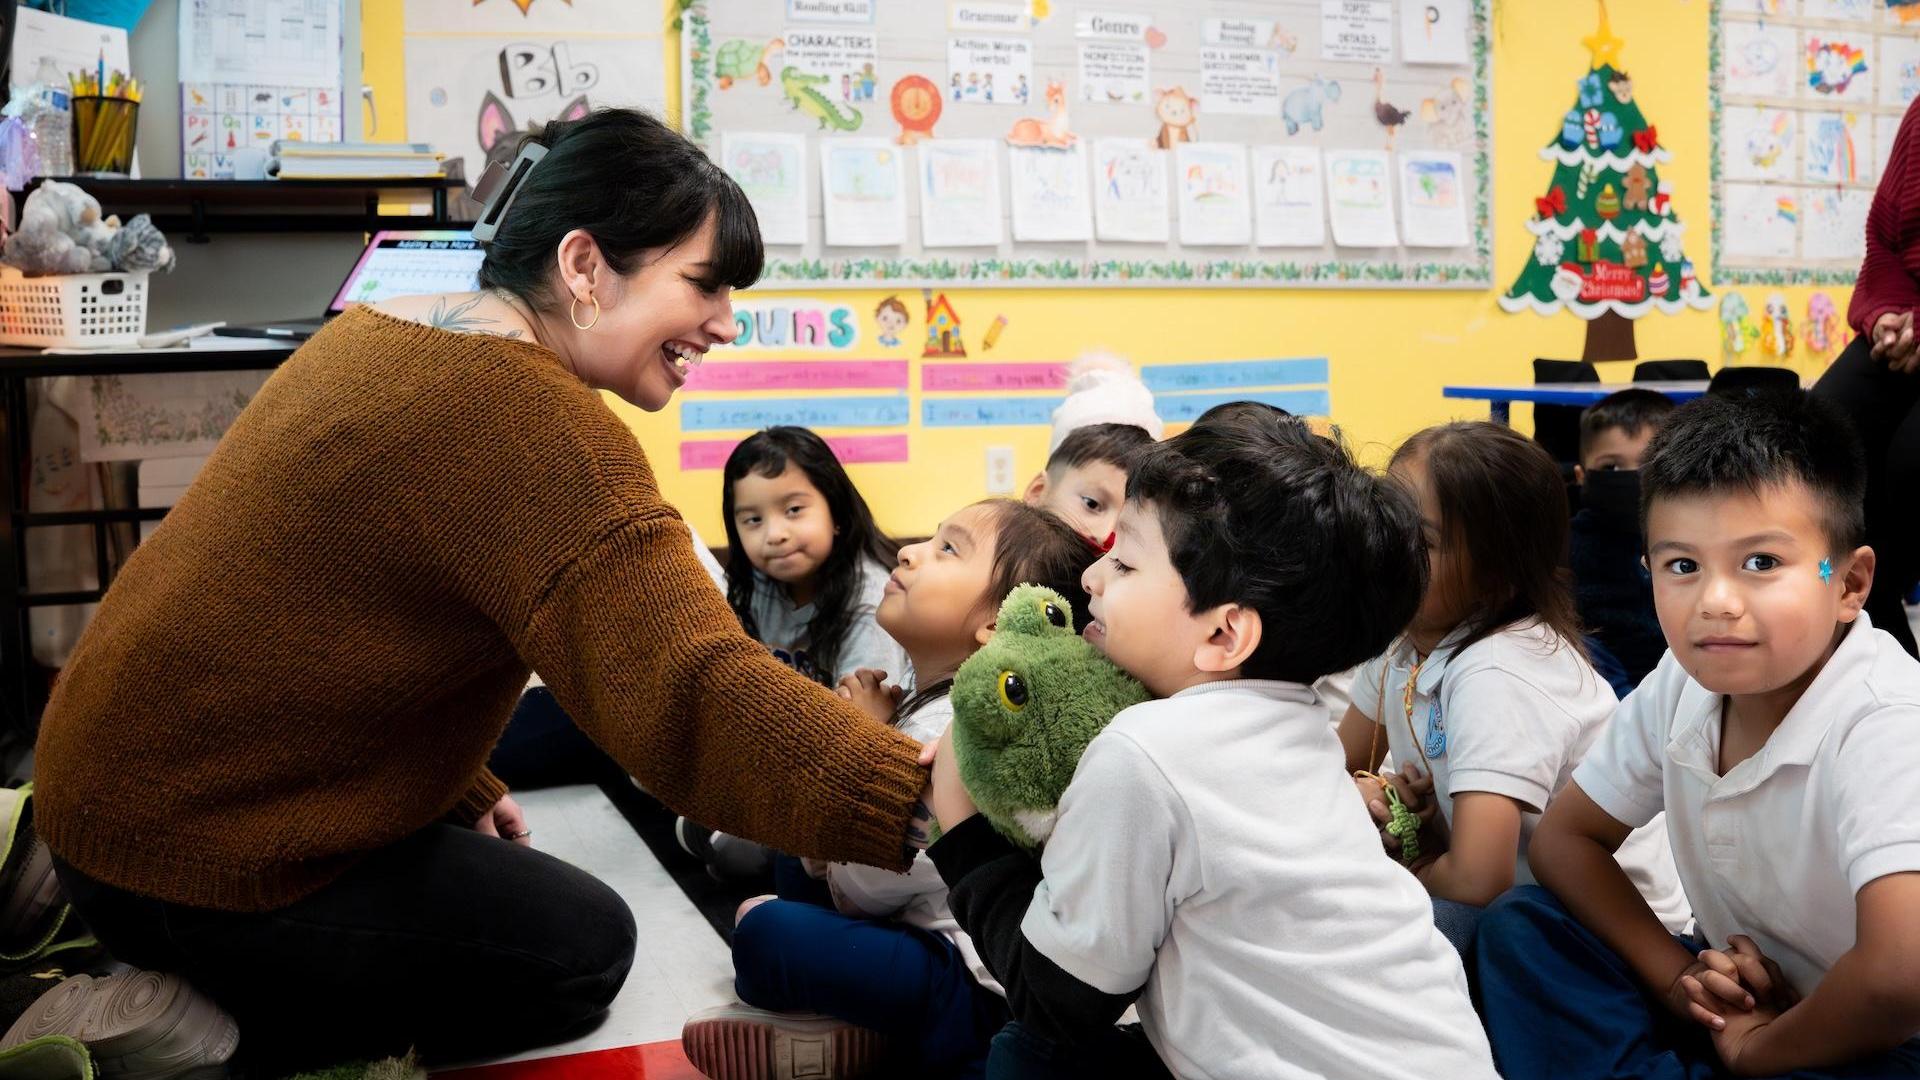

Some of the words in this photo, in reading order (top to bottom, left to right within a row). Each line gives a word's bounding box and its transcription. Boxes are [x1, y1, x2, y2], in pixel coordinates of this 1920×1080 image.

[959, 9, 1018, 23] Grammar
[1091, 16, 1139, 34] Genre
[787, 34, 873, 49] CHARACTERS
[499, 40, 600, 100] Bb
[397, 240, 429, 249] Adding
[430, 240, 449, 249] One
[450, 240, 475, 249] More
[1594, 263, 1632, 282] Merry
[732, 307, 855, 348] ouns
